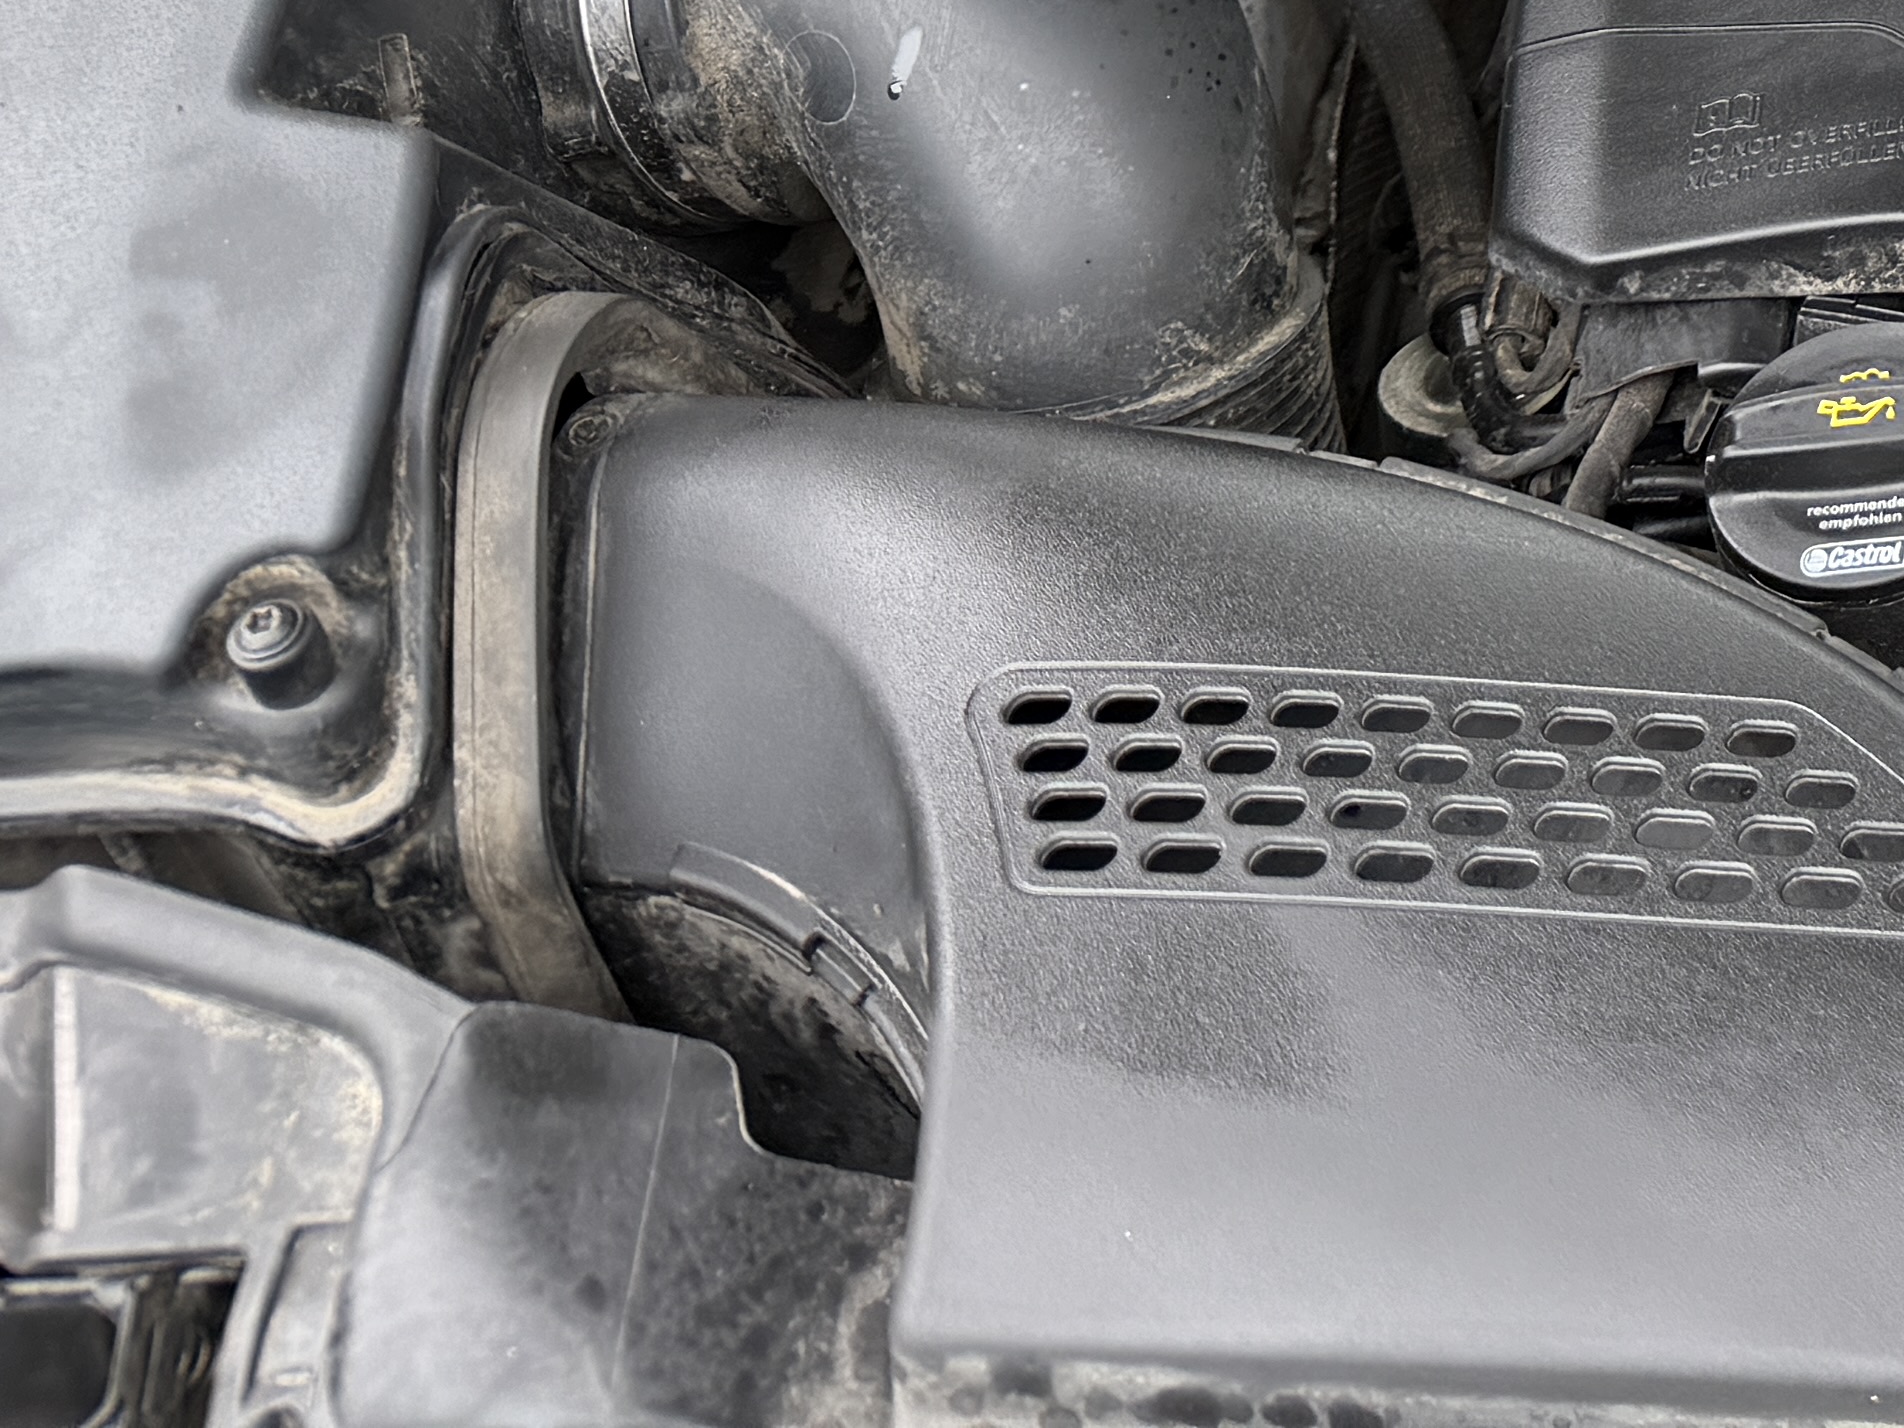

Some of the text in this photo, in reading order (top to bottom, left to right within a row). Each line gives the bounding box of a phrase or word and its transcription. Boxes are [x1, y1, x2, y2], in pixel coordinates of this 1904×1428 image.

[1689, 144, 1724, 165] DO
[1731, 134, 1782, 158] NOT
[1684, 164, 1758, 190] NICHT
[1818, 512, 1902, 530] empfohlen
[1827, 541, 1902, 569] Castrol
